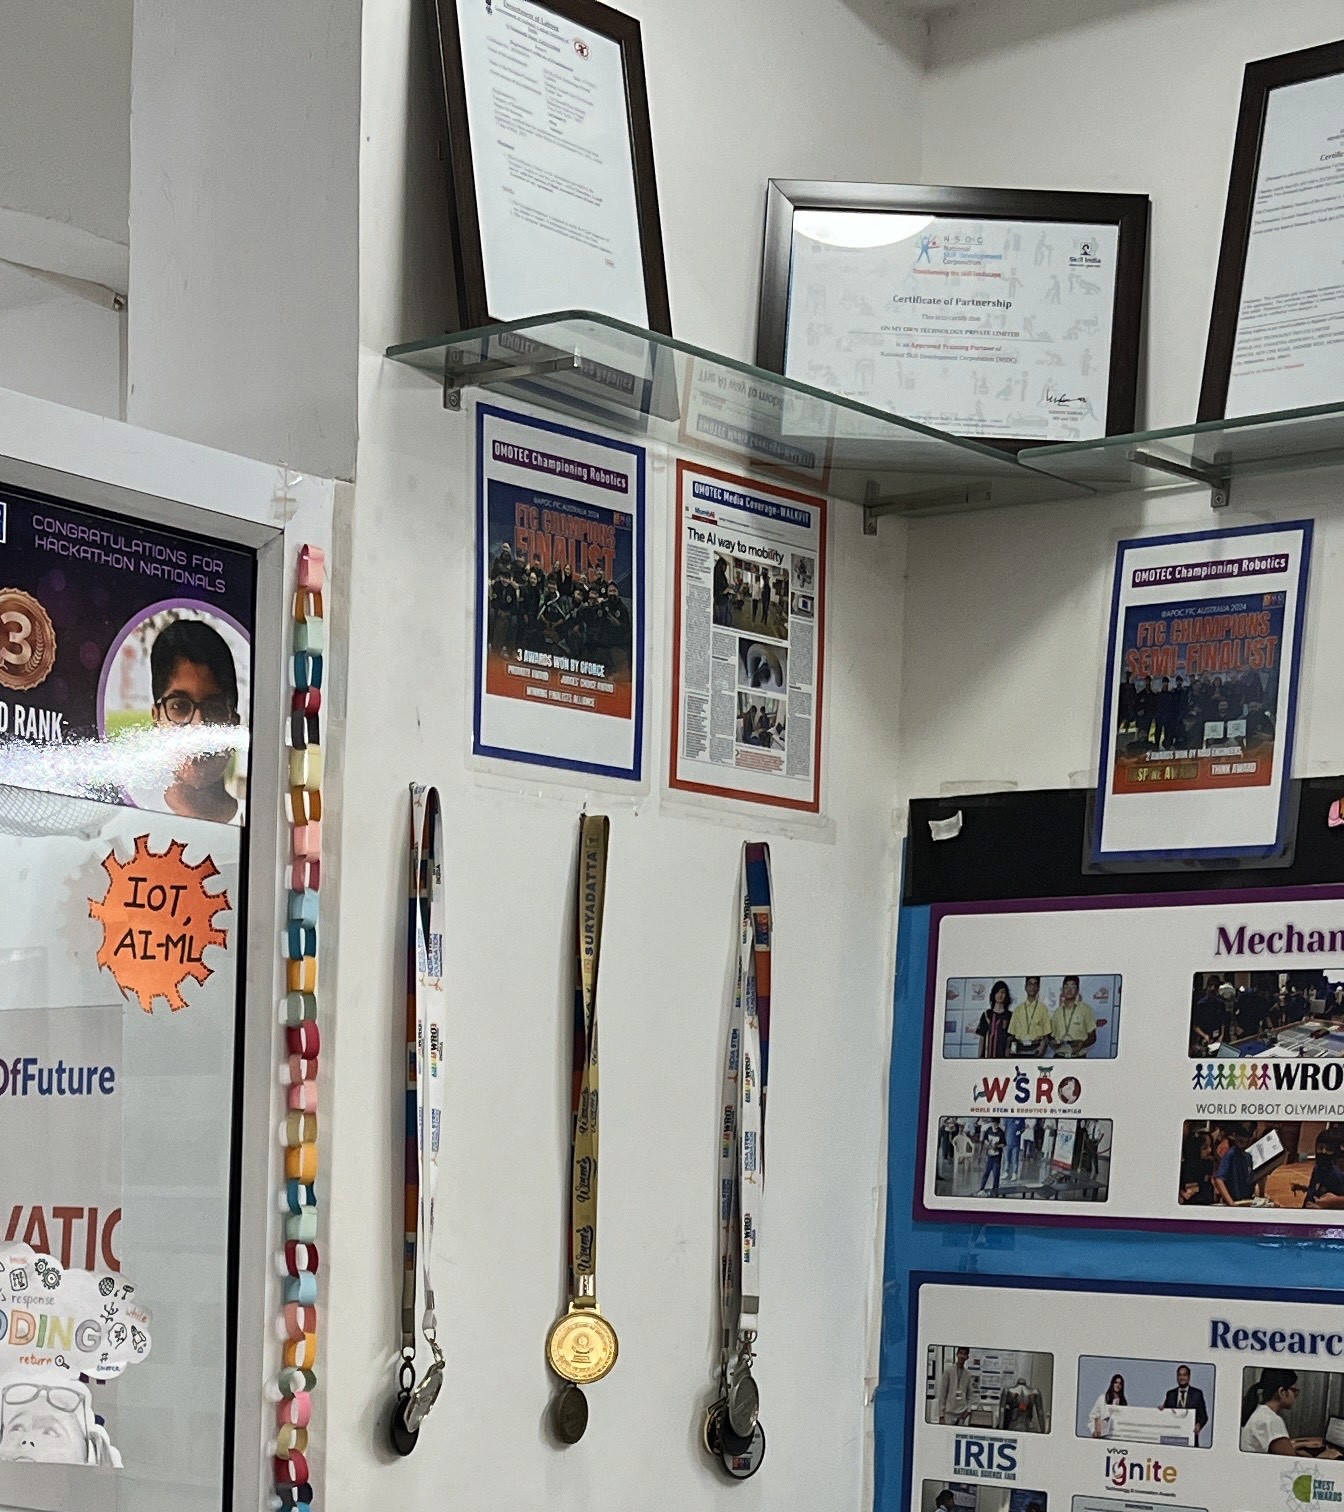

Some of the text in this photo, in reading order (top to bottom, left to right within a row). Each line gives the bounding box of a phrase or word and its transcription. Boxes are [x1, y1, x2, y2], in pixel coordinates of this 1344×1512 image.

[892, 293, 1013, 310] Certificate of Partnership
[494, 442, 627, 489] OMOTEC Championing Robotics
[694, 482, 722, 499] OMOTEC
[723, 490, 744, 506] Media
[32, 514, 187, 566] CONGRATULATIONS
[192, 556, 224, 575] FOR
[687, 526, 784, 566] The AI way to mobility
[34, 534, 226, 593] HACKATHON NATIONALS
[1134, 557, 1286, 583] OMOTEC Championing Robotics
[0, 610, 33, 664] 3
[1137, 610, 1272, 648] FTC CHAMPIONS
[1127, 635, 1278, 680] SEMI-FINALIST
[123, 876, 194, 926] IOT,
[584, 850, 598, 958] SURYADATTA
[113, 928, 202, 965] AI-ML
[981, 1075, 1082, 1105] WSRO
[1196, 1102, 1281, 1115] WORLD ROBOT
[19, 1354, 53, 1366] return
[954, 1439, 1018, 1472] IRIS
[1106, 1447, 1129, 1456] vivo
[1105, 1456, 1178, 1486] Ignite
[1313, 1480, 1336, 1492] CREST
[1313, 1489, 1342, 1503] AWARDS
